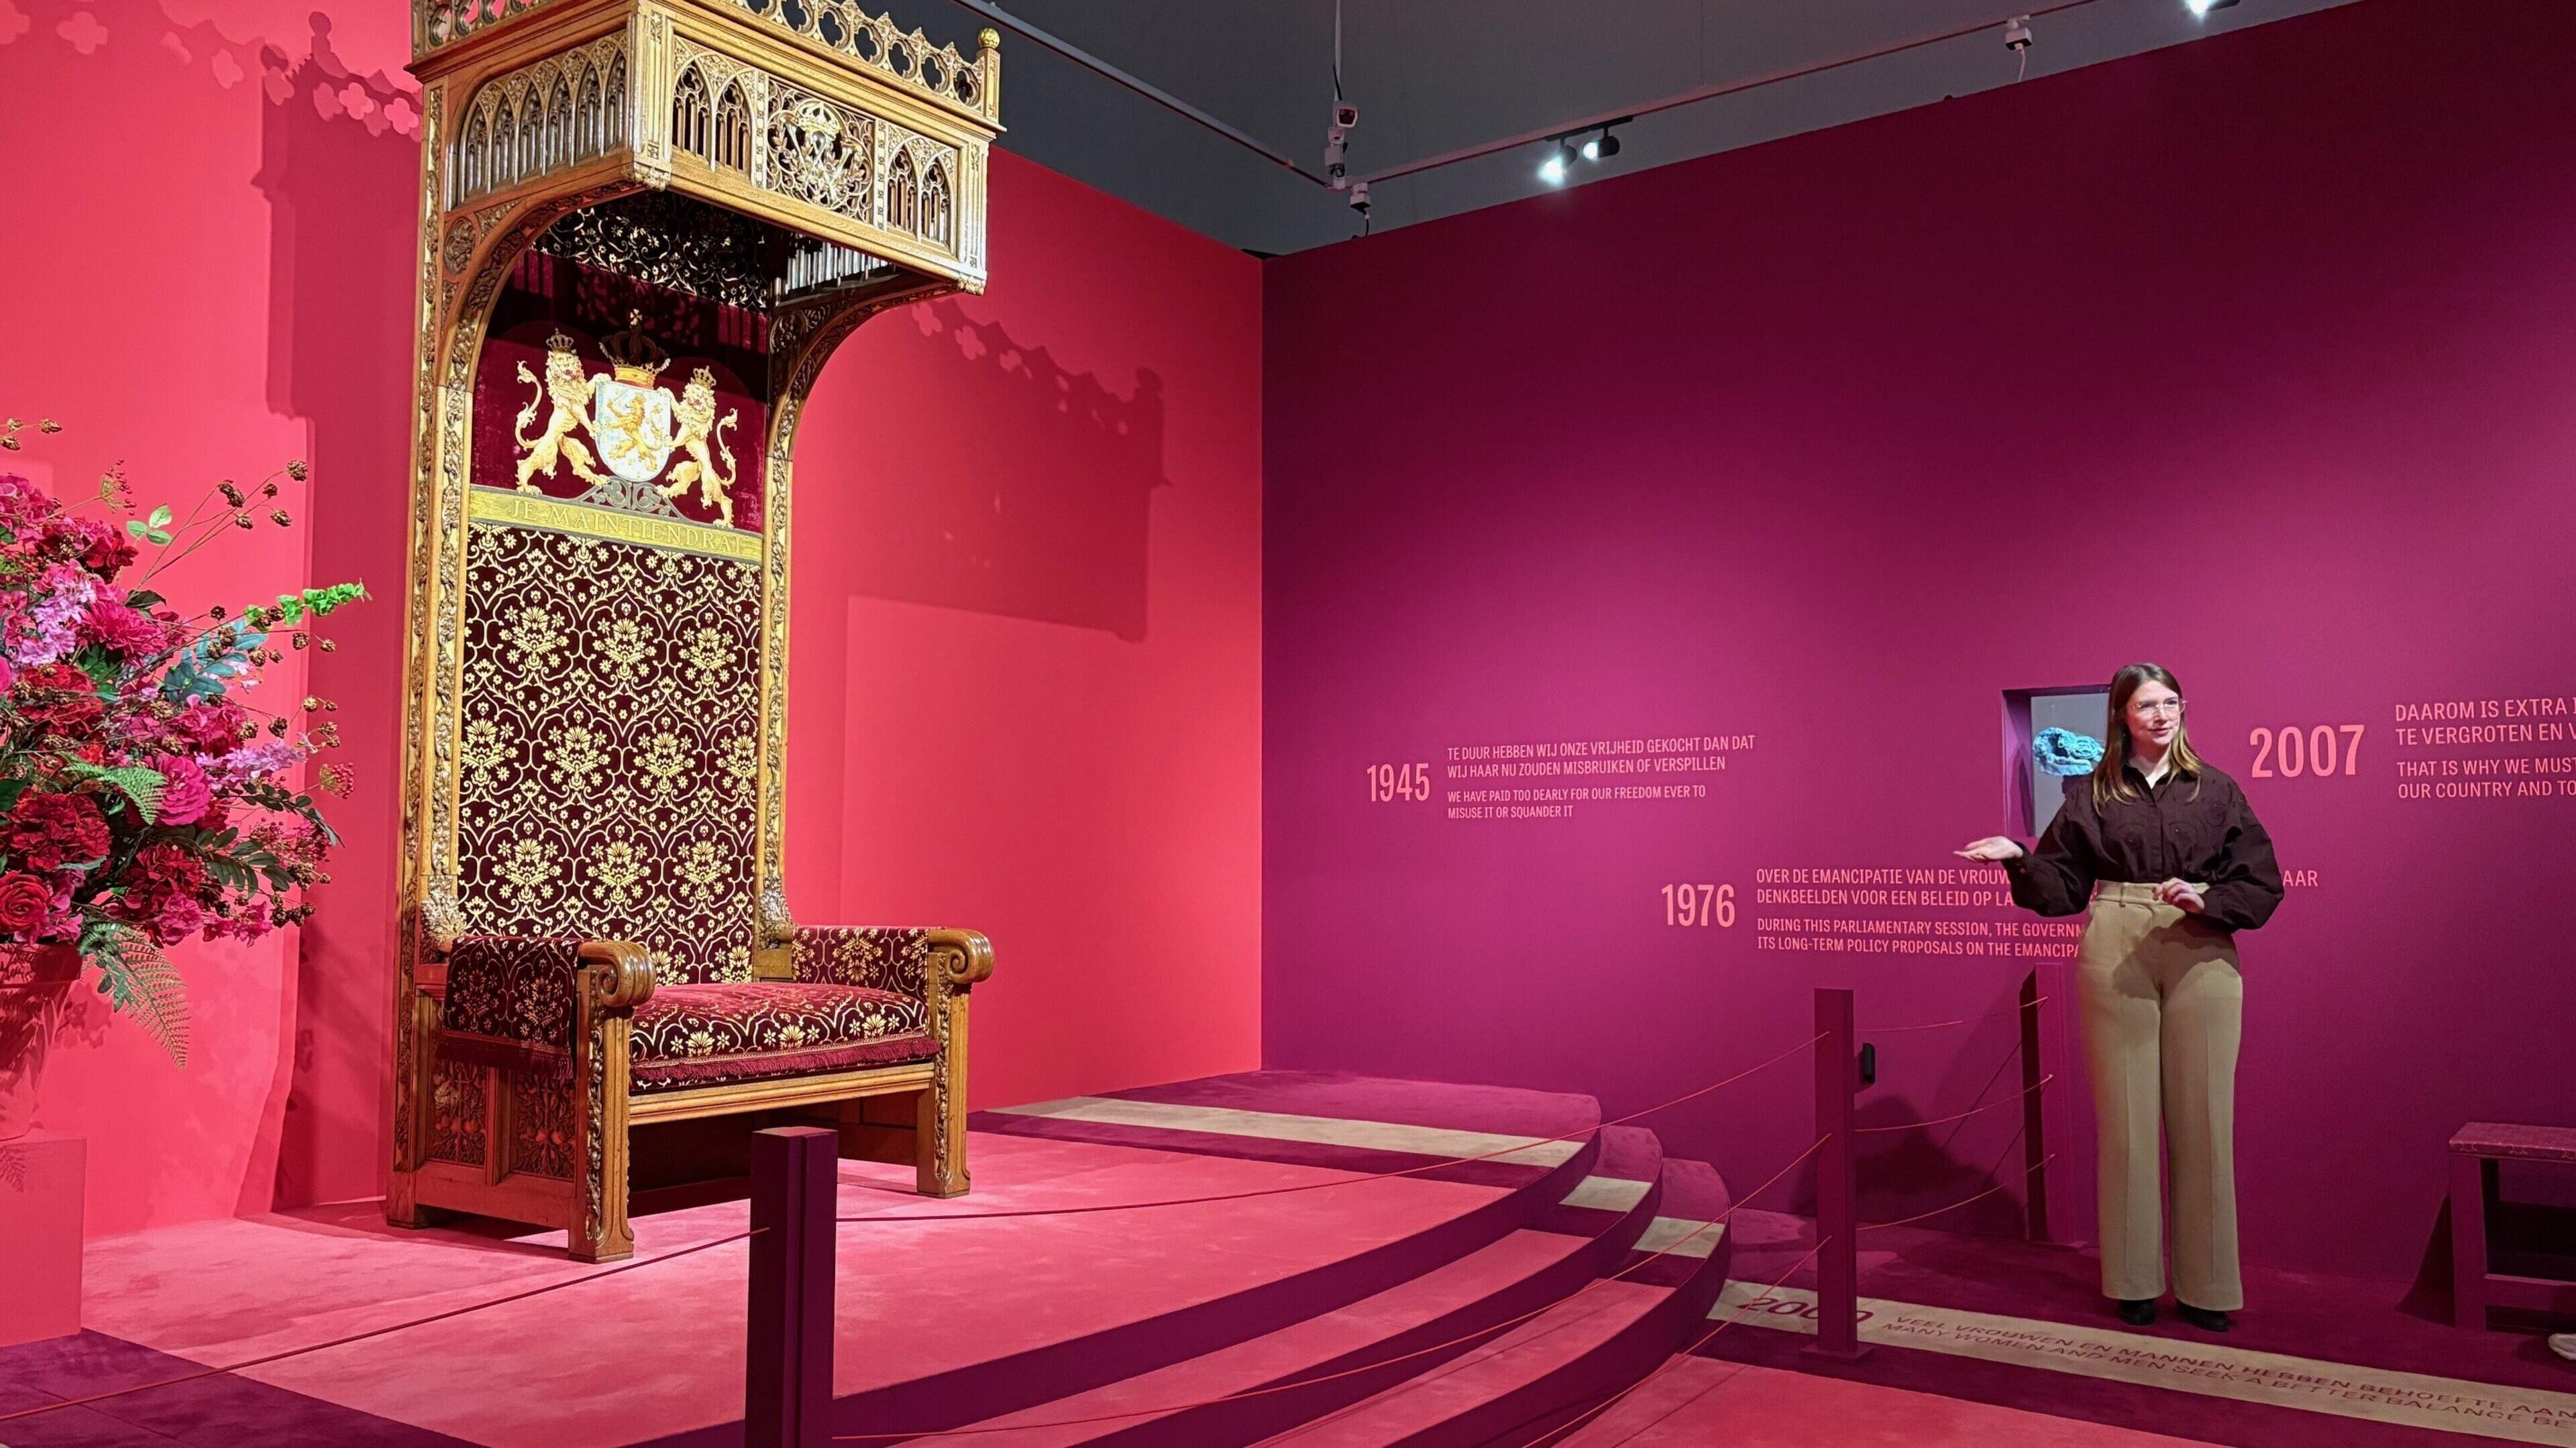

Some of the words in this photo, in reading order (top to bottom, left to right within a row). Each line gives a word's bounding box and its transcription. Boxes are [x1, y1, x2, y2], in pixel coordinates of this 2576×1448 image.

[508, 499, 537, 520] JE
[547, 505, 741, 555] MAINTIENDRAI
[2396, 702, 2474, 721] DAAROM
[2481, 701, 2499, 718] IS
[2506, 698, 2567, 716] EXTRA
[2396, 728, 2417, 745] TE
[2422, 724, 2532, 744] VERGROTEN
[2539, 723, 2562, 740] EN
[1448, 748, 1460, 760] TE
[1462, 746, 1489, 759] DUUR
[1493, 745, 1534, 759] HEBBEN
[1536, 744, 1557, 757] WIJ
[1560, 742, 1588, 756] ONZE
[1591, 740, 1644, 755] VRIJHEID
[1647, 738, 1701, 753] GEKOCHT
[1704, 736, 1728, 750] DAN
[1733, 735, 1755, 749] DAT
[2250, 725, 2364, 777] 2007
[1448, 765, 1466, 778] WIJ
[1470, 765, 1498, 777] HAAR
[1502, 764, 1516, 776] NU
[1519, 762, 1560, 775] ZOUDEN
[1564, 760, 1633, 774] MISBRUIKEN
[1637, 759, 1651, 772] OF
[1654, 757, 1725, 771] VERSPILLEN
[2397, 761, 2436, 776] THAT
[2442, 761, 2458, 775] IS
[2463, 759, 2500, 775] WHY
[2505, 759, 2530, 773] WE
[1367, 763, 1430, 801] 1945
[2399, 783, 2430, 798] OUR
[2436, 782, 2512, 797] COUNTRY
[2518, 781, 2552, 796] AND
[1448, 791, 1461, 802] WE
[1464, 791, 1487, 801] HAVE
[1489, 790, 1510, 801] PAID
[1513, 789, 1530, 801] TOO
[1534, 789, 1568, 801] DEARLY
[1571, 788, 1589, 799] FOR
[1592, 788, 1611, 799] OUR
[1615, 786, 1661, 799] FREEDOM
[1664, 785, 1690, 797] EVER
[1693, 785, 1705, 797] TO
[1448, 807, 1482, 818] MISUSE
[1485, 807, 1493, 818] IT
[1496, 807, 1508, 818] OR
[1511, 806, 1561, 819] SQUANDER
[1564, 805, 1573, 817] IT
[1757, 869, 1789, 883] OVER
[1793, 869, 1809, 883] DE
[1813, 869, 1902, 883] EMANCIPATIE
[1907, 869, 1934, 884] VAN
[1939, 869, 1955, 884] DE
[1662, 884, 1735, 927] 1976
[1758, 889, 1847, 904] DENKBEELDEN
[1851, 890, 1887, 905] VOOR
[1892, 891, 1916, 905] EEN
[1921, 891, 1968, 905] BELEID
[1974, 891, 1991, 905] OP
[1758, 918, 1801, 931] DURING
[1804, 920, 1830, 932] THIS
[1834, 920, 1931, 934] PARLIAMENTARY
[1935, 922, 1992, 937] SESSION,
[1995, 923, 2019, 936] THE
[1758, 937, 1775, 949] ITS
[1779, 937, 1843, 950] LONG-TERM
[1847, 939, 1889, 952] POLICY
[1892, 940, 1962, 954] PROPOSALS
[1967, 942, 1983, 954] ON
[1987, 942, 2010, 955] THE
[1897, 1317, 1945, 1328] VEEL
[1956, 1325, 2073, 1345] VROUWEN
[2080, 1343, 2112, 1352] EN
[2119, 1349, 2234, 1370] MANNEN
[2241, 1366, 2350, 1388] HEBBEN
[2360, 1384, 2503, 1409] BEHOEFTE
[1882, 1323, 1951, 1337] MANY
[1955, 1333, 2045, 1351] WOMEN
[2048, 1347, 2102, 1359] AND
[2110, 1356, 2165, 1370] MEN
[2171, 1366, 2235, 1381] SEEK
[2245, 1377, 2261, 1385] A
[2271, 1380, 2377, 1402] BETTER
[2386, 1397, 2522, 1421] BALANCE
[2532, 1416, 2576, 1429] BE
